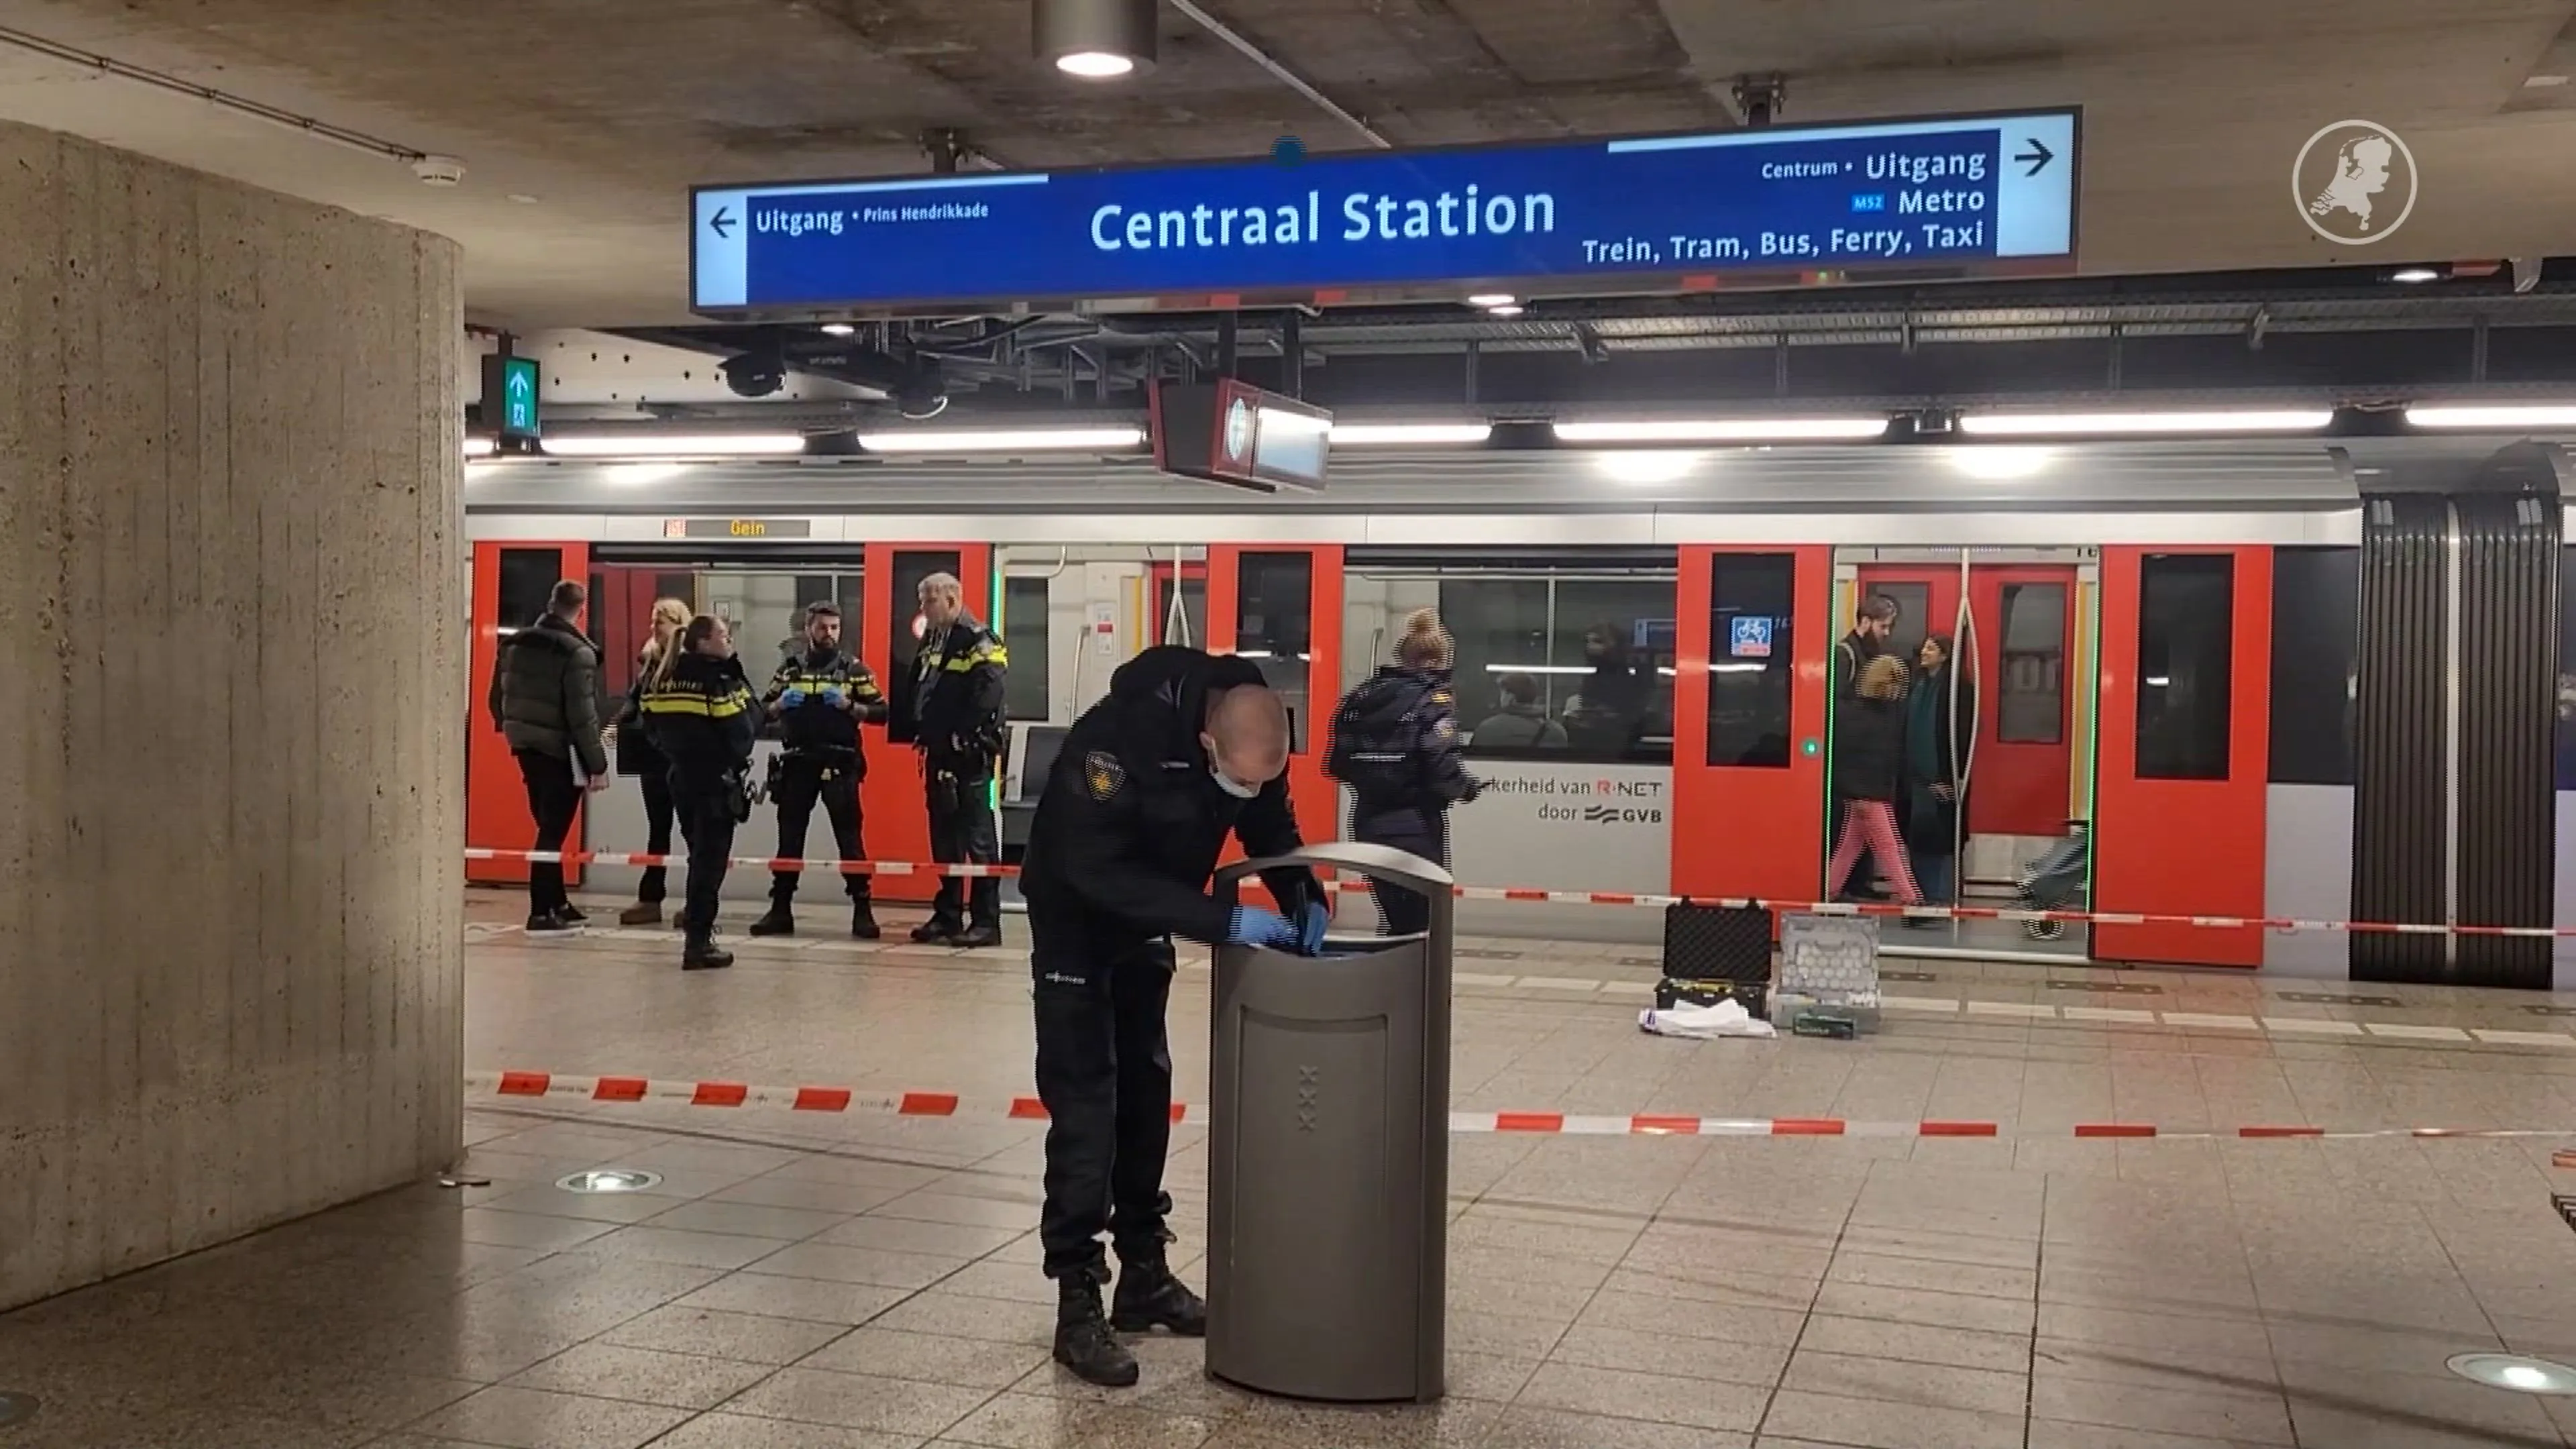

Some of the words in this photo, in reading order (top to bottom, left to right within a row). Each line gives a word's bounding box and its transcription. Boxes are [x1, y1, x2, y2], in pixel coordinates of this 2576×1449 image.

[1762, 162, 1838, 179] Centrum
[1866, 152, 1986, 184] Uitgang
[1854, 197, 1882, 209] M52
[1898, 189, 1985, 214] Metro
[756, 209, 843, 236] Uitgang
[863, 207, 898, 223] Prins
[901, 202, 989, 221] Hendrikkade
[1090, 189, 1319, 250] Centraal
[1343, 184, 1555, 241] Station
[1582, 237, 1660, 265] Trein,
[1669, 236, 1750, 260] Tram,
[1760, 231, 1819, 257] Bus,
[1831, 228, 1911, 257] Ferry,
[1922, 220, 1984, 249] Taxi
[730, 520, 765, 535] Gein
[1560, 780, 1591, 794] van
[1538, 804, 1578, 820] door
[1622, 809, 1662, 824] GVB
